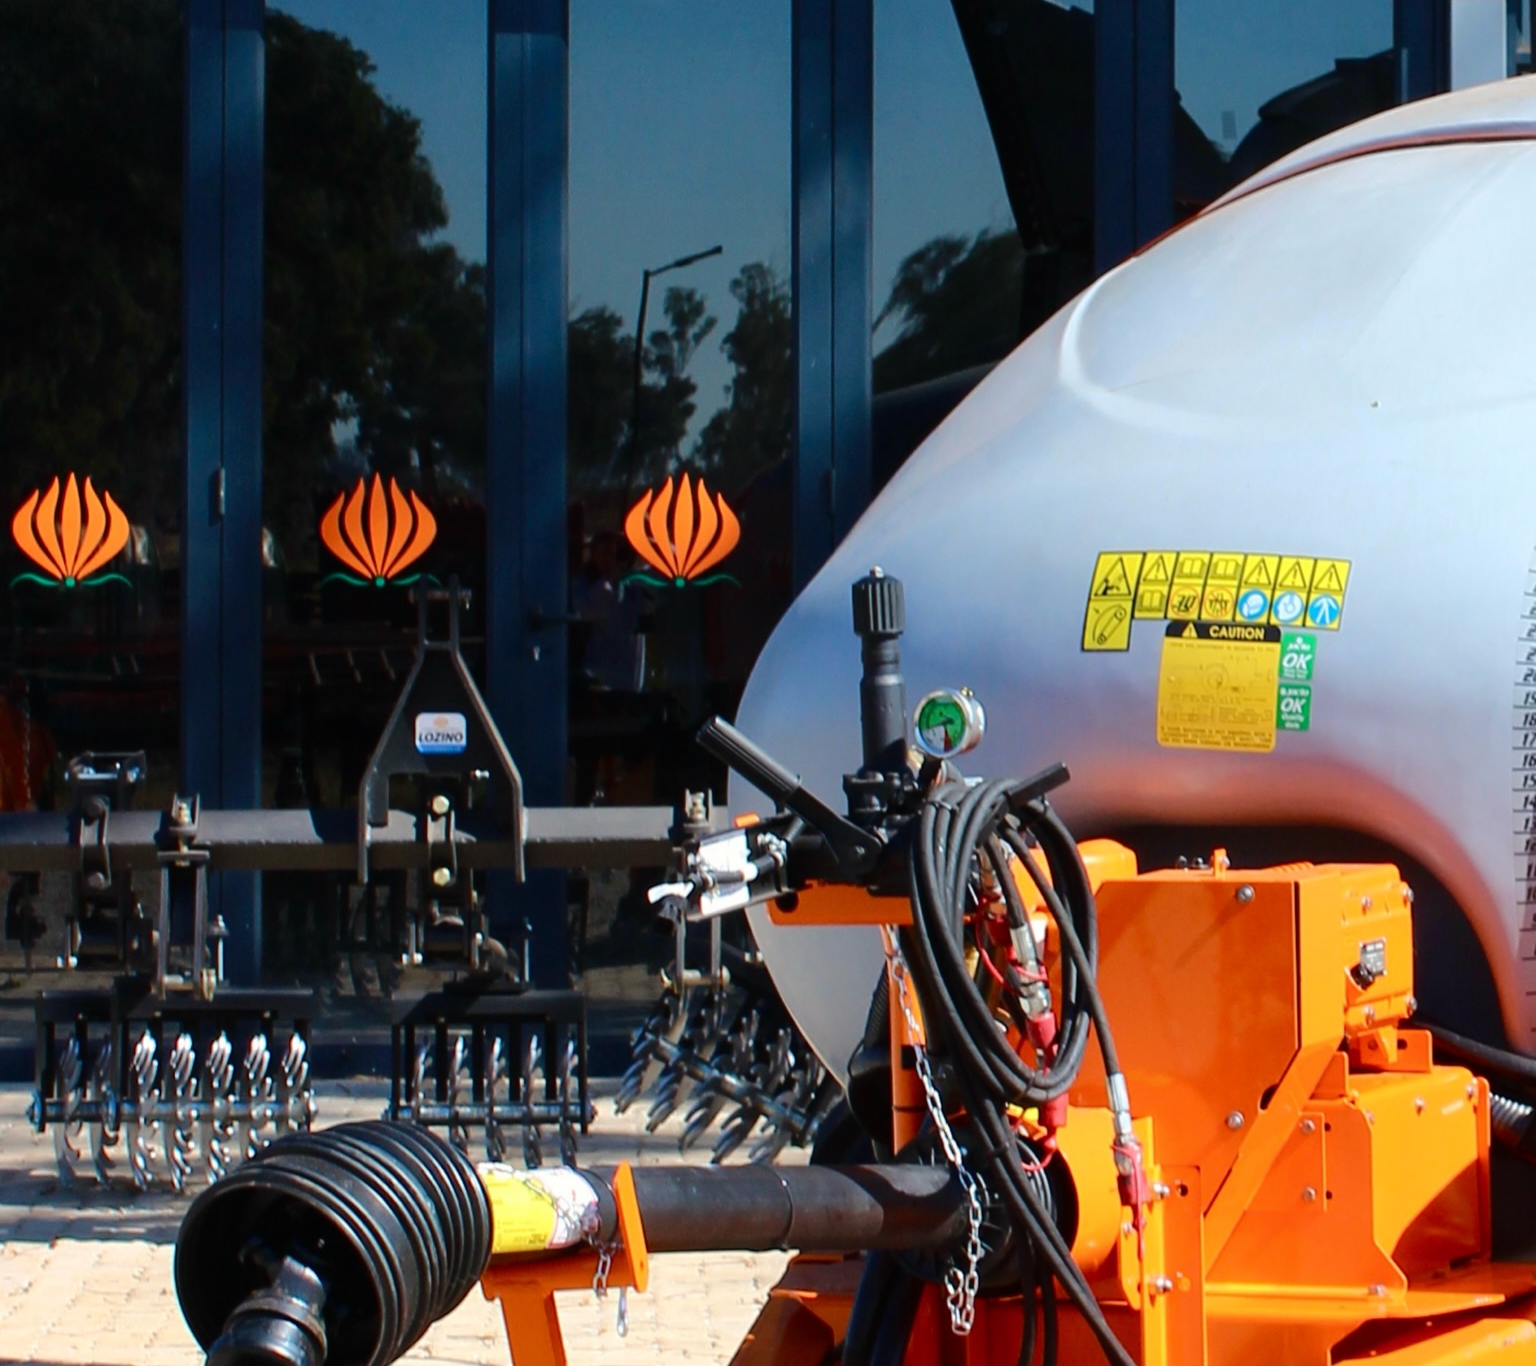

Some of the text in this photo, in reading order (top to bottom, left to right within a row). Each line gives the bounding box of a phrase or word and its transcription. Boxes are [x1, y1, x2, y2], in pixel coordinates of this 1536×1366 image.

[1209, 624, 1266, 640] CAUTION
[1282, 652, 1313, 669] OK
[1281, 696, 1306, 713] OK
[419, 731, 463, 743] LOZINO
